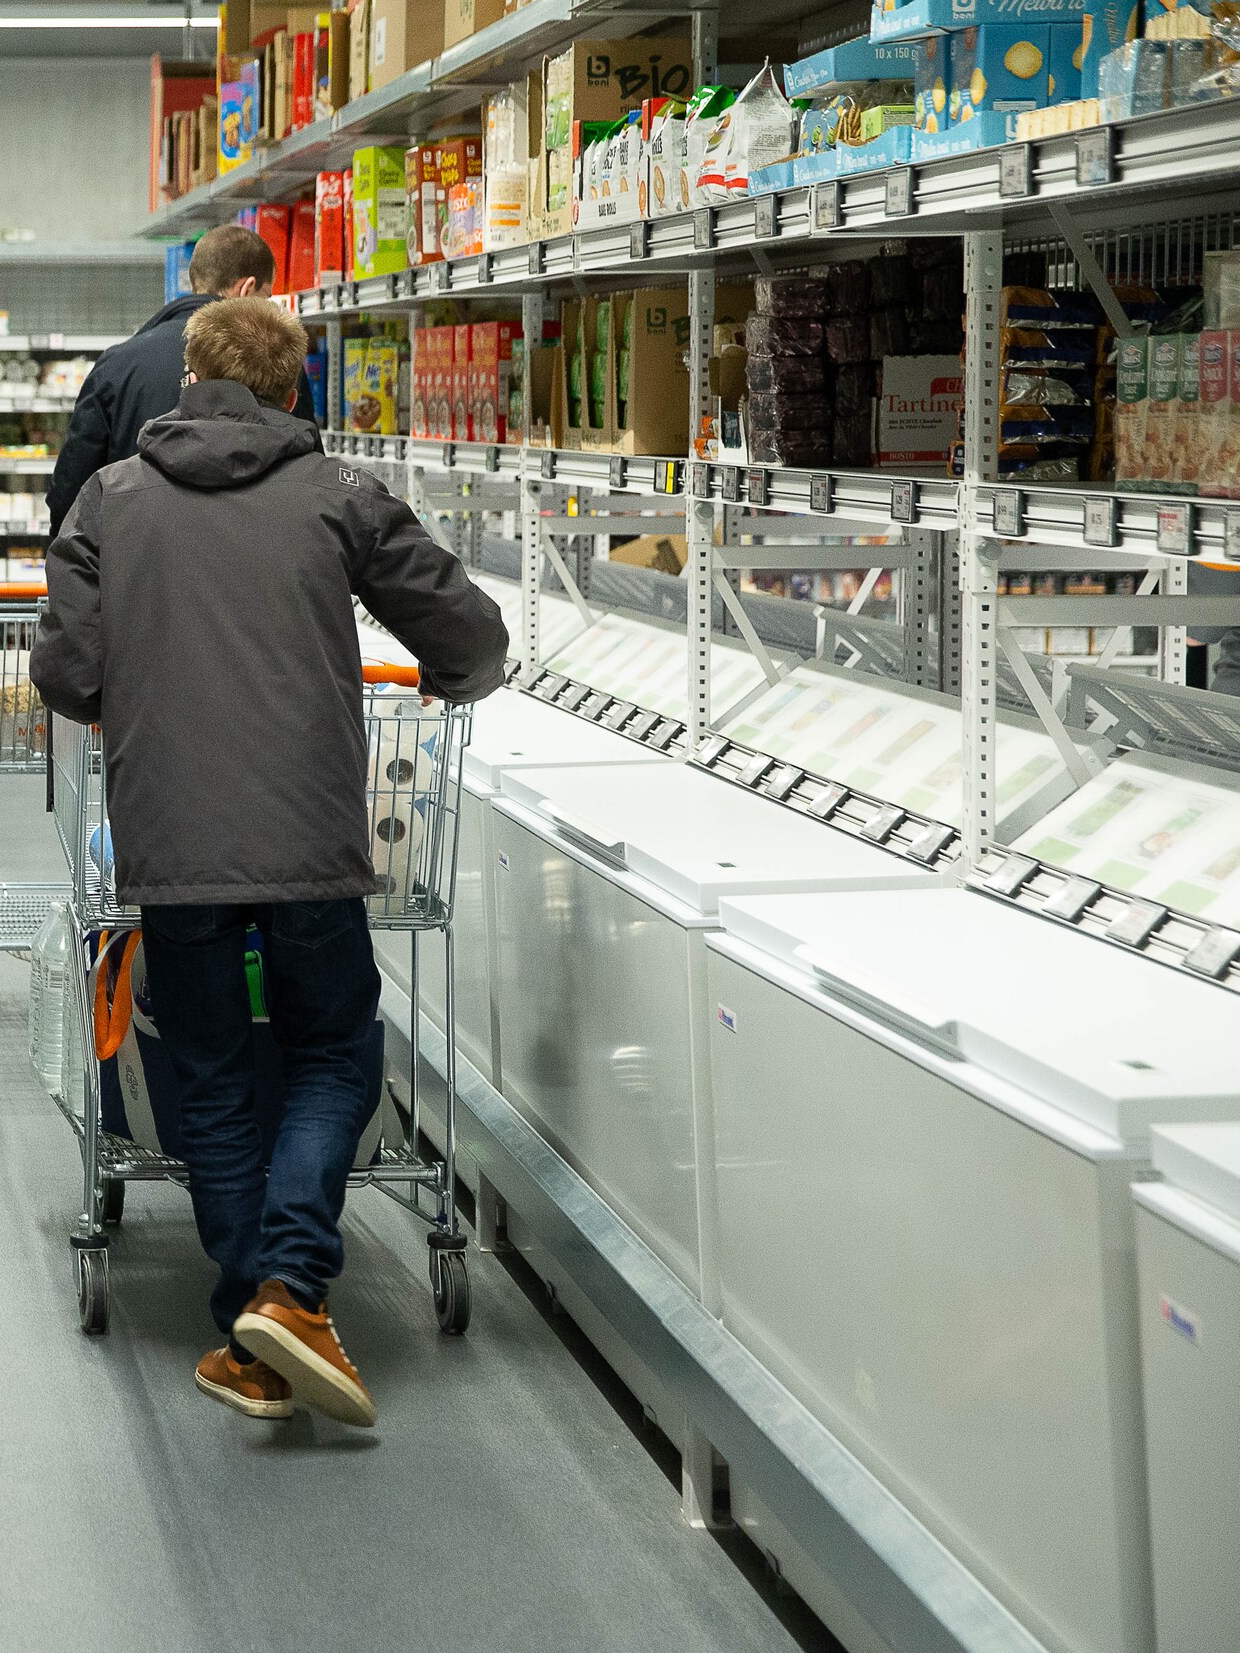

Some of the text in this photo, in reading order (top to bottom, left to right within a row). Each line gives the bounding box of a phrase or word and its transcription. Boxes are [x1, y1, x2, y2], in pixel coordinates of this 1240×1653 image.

[875, 48, 884, 59] 10
[895, 47, 909, 58] 150
[588, 79, 609, 87] boni
